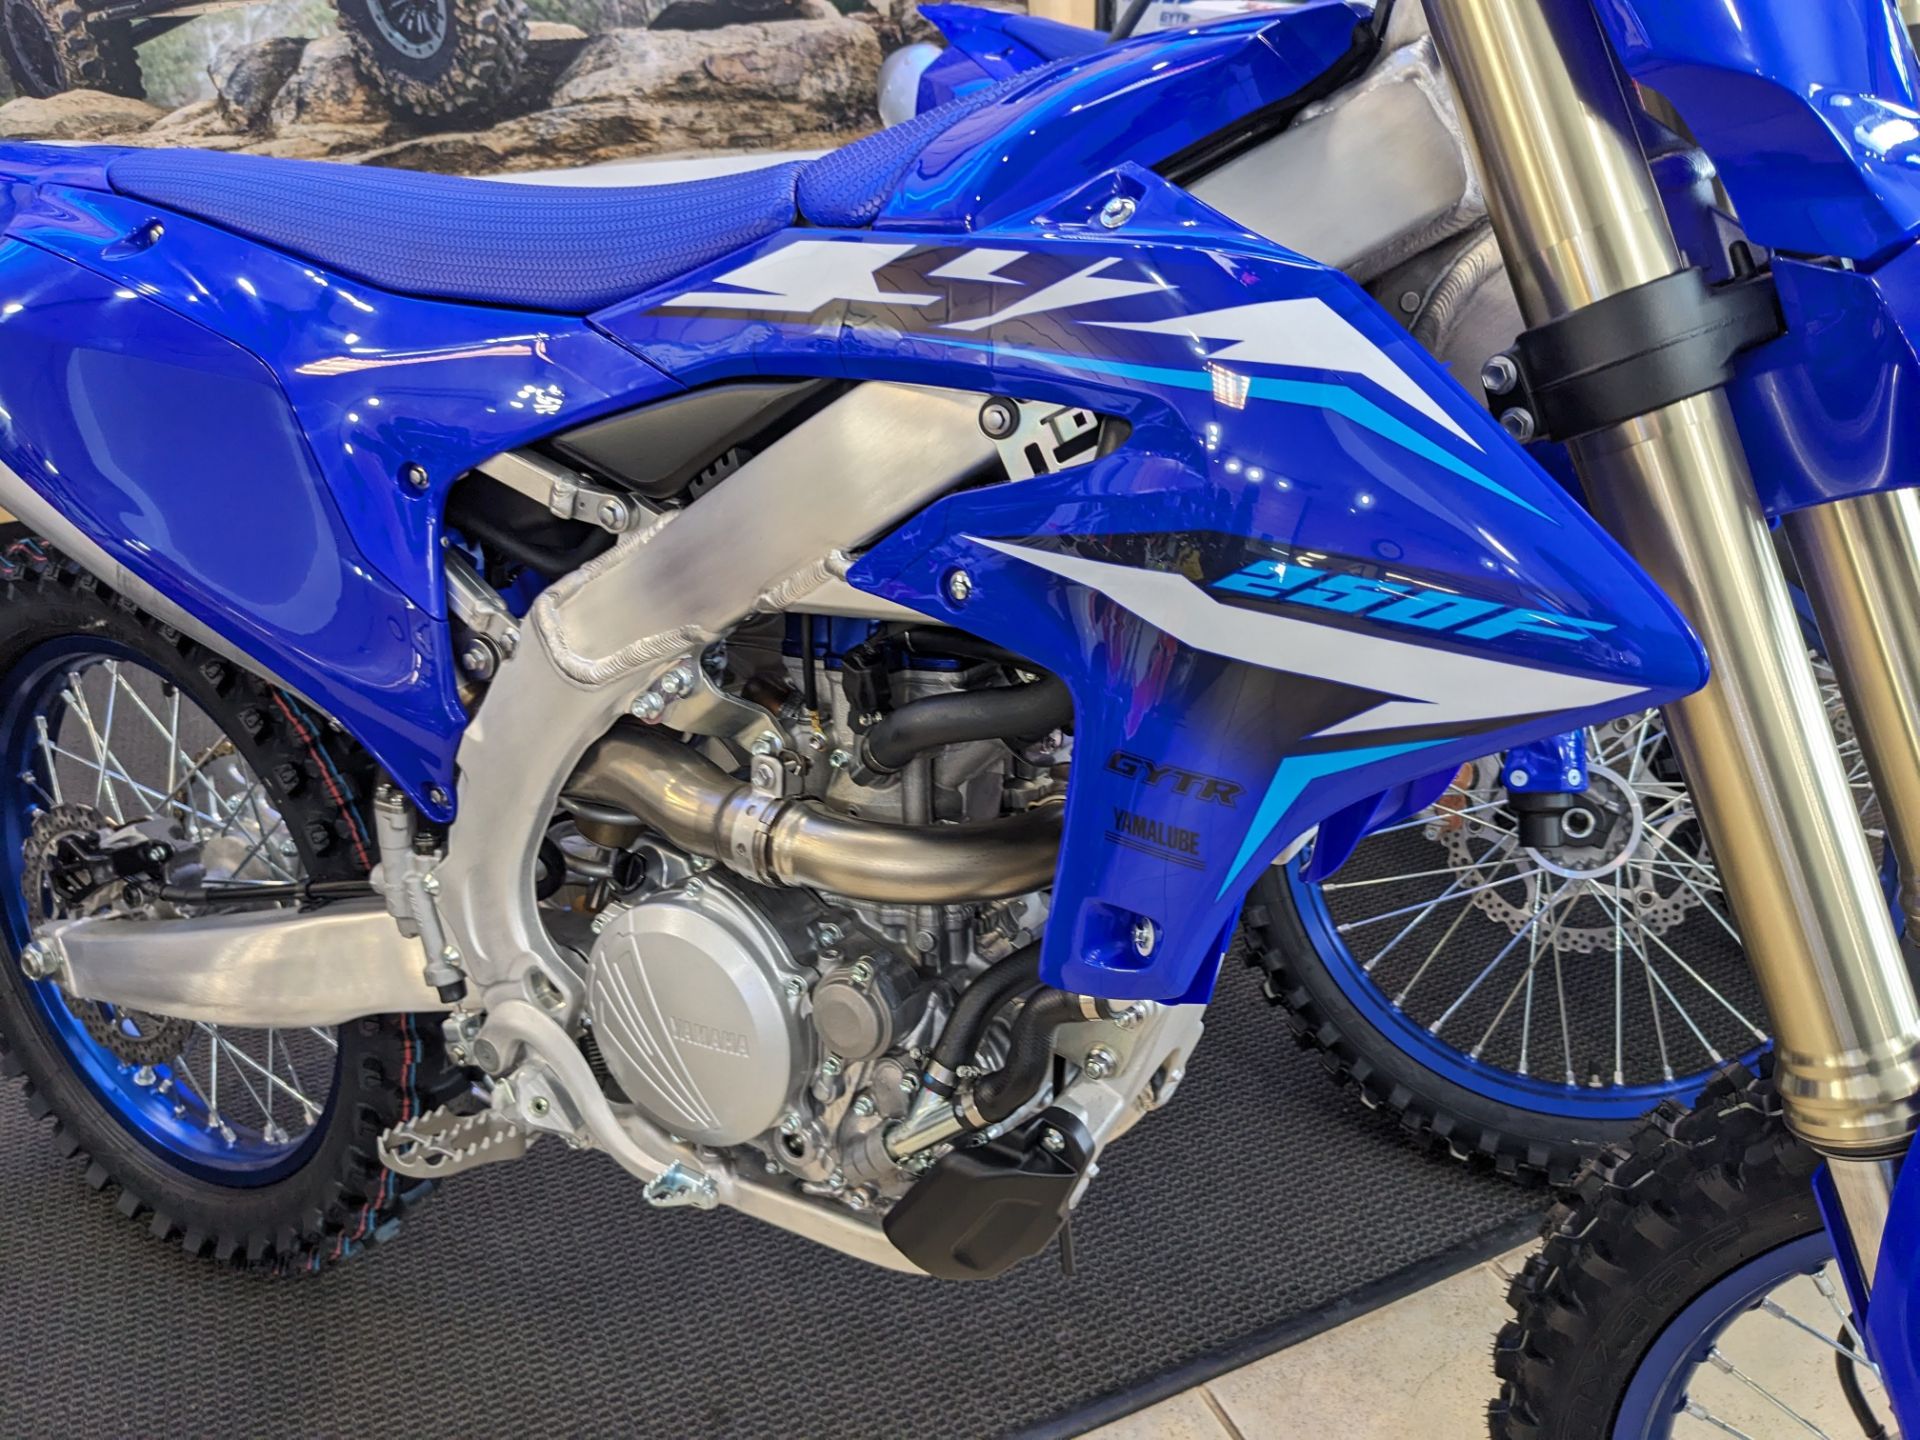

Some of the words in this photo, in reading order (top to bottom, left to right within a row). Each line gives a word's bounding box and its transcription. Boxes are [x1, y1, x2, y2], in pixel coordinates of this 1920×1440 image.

[1209, 559, 1619, 641] 250F
[1104, 750, 1246, 809] GYTR
[1113, 806, 1201, 855] YAMALUBE
[669, 1016, 750, 1058] YAMAHA
